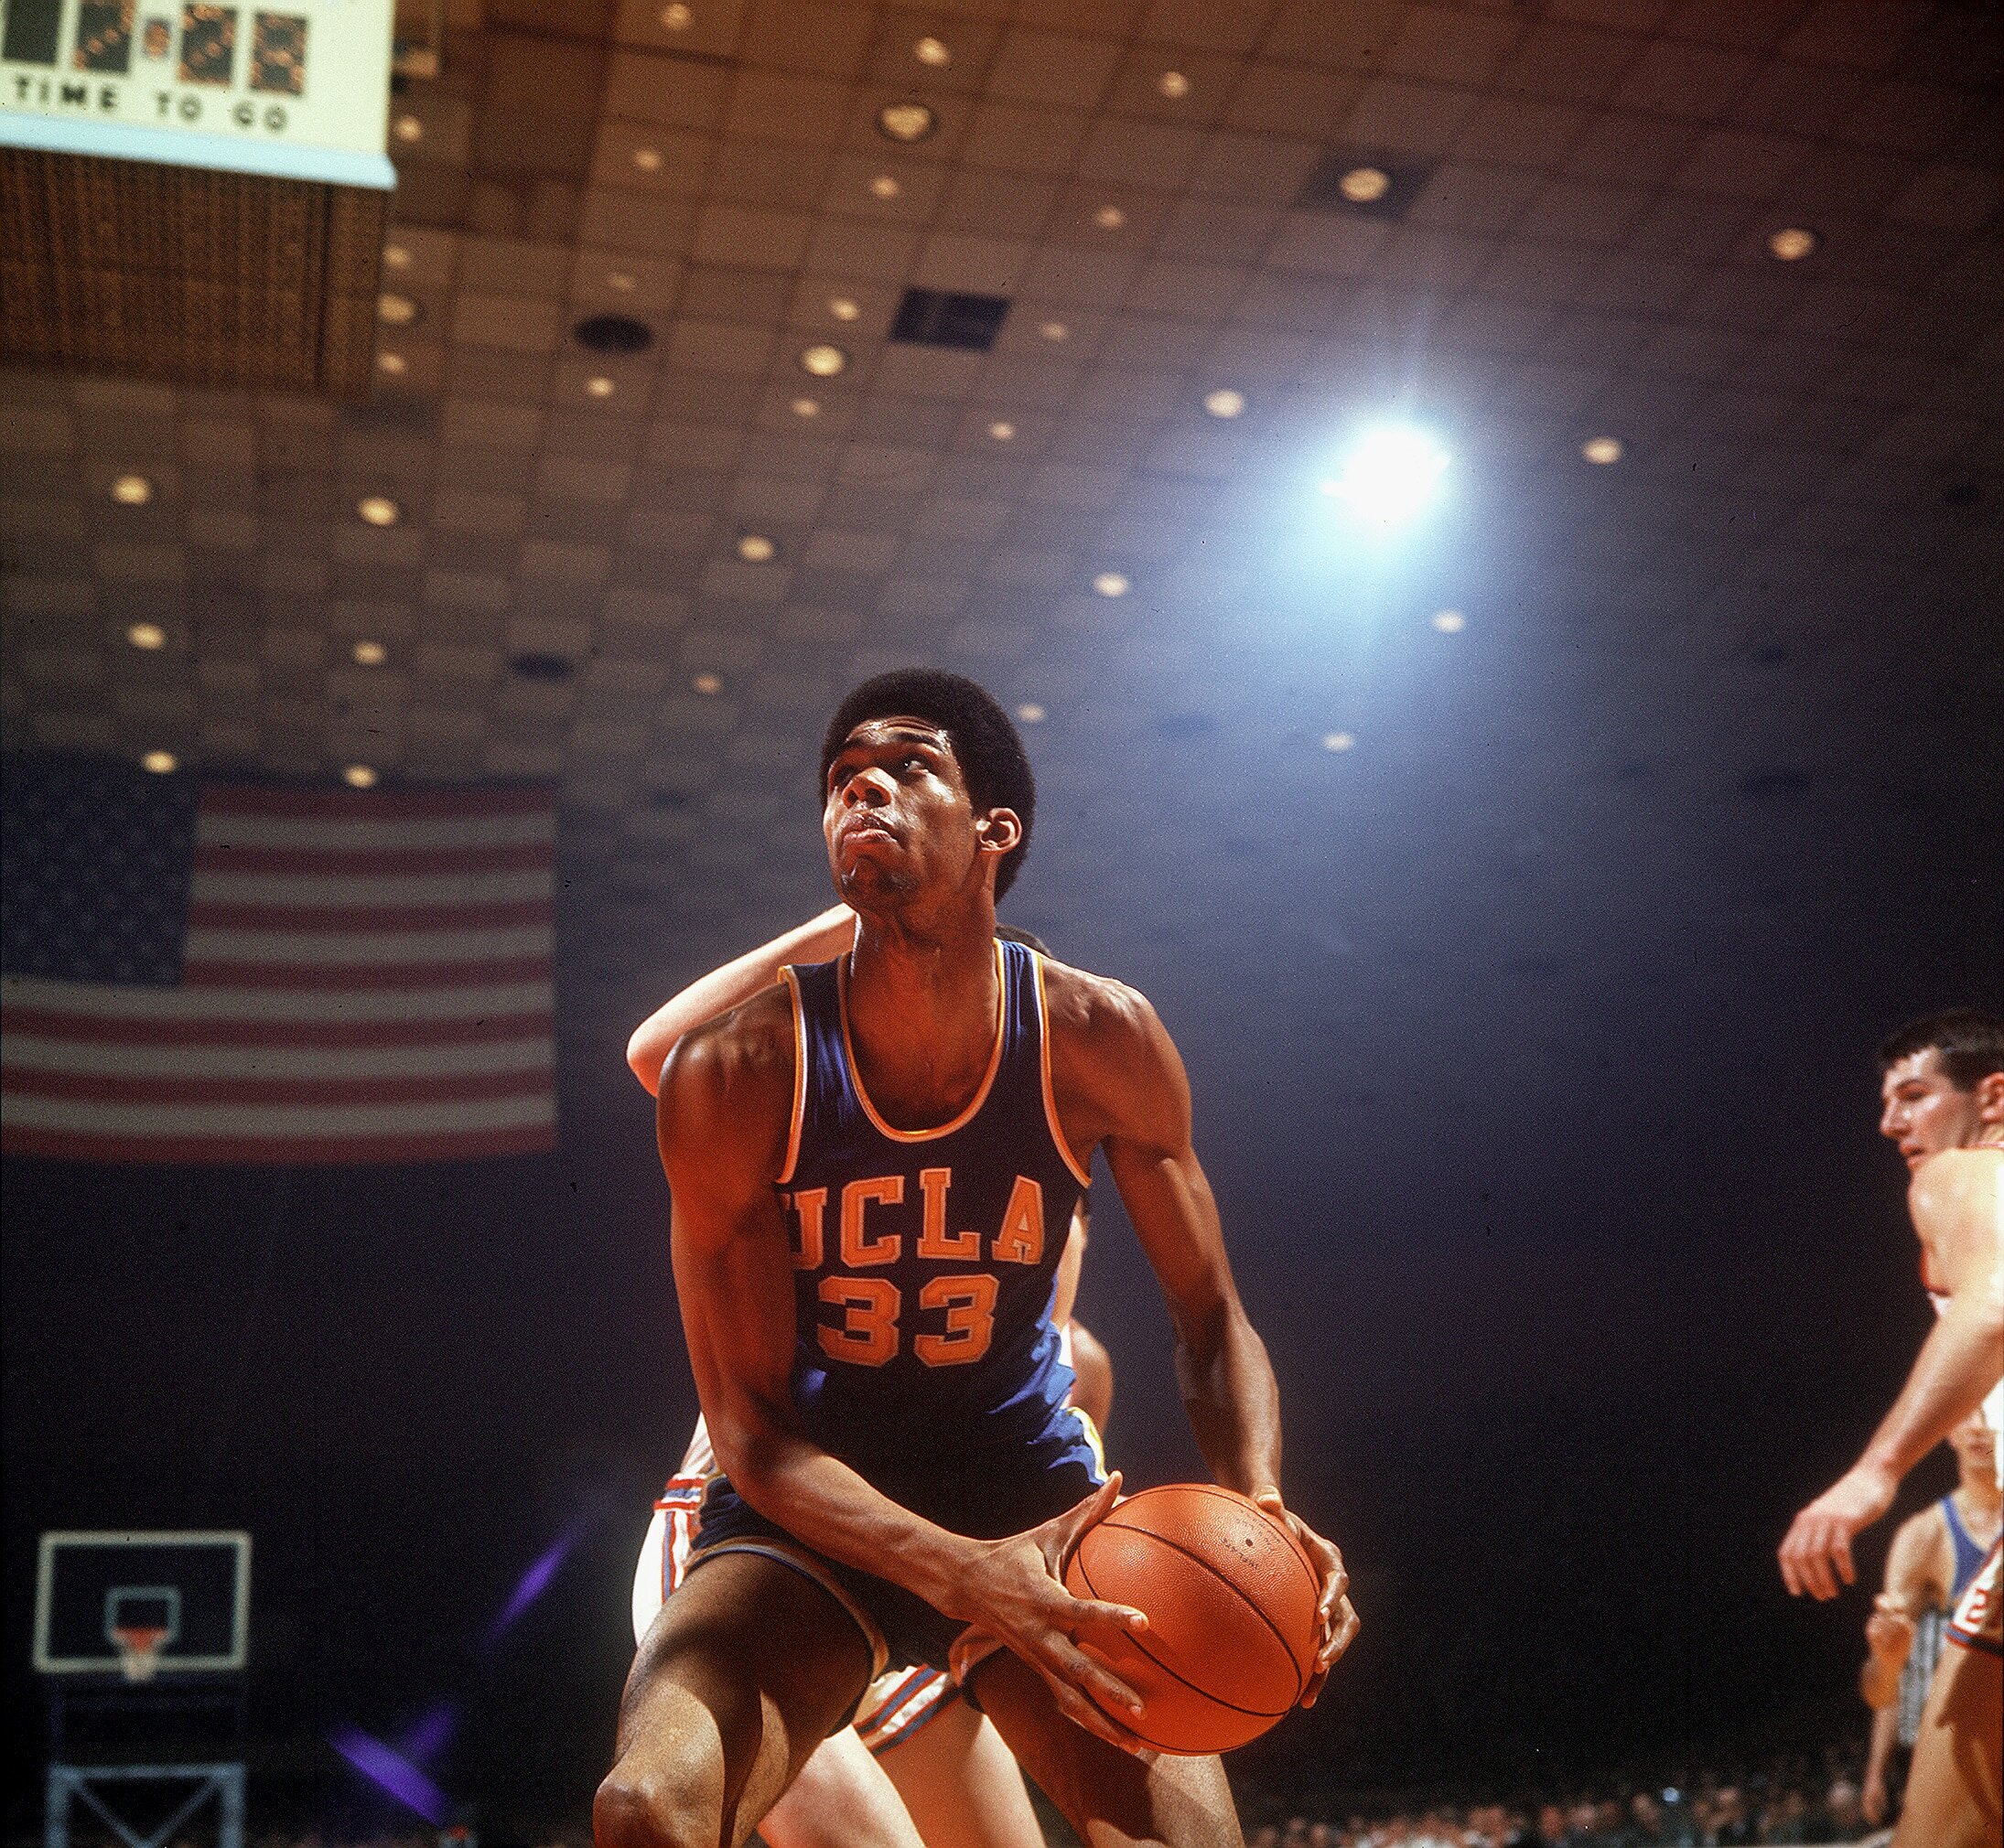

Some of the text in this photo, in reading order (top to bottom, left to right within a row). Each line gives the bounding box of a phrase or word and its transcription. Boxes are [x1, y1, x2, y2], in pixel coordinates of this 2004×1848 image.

[16, 75, 289, 133] TIME TO GO
[817, 1273, 999, 1368] 33
